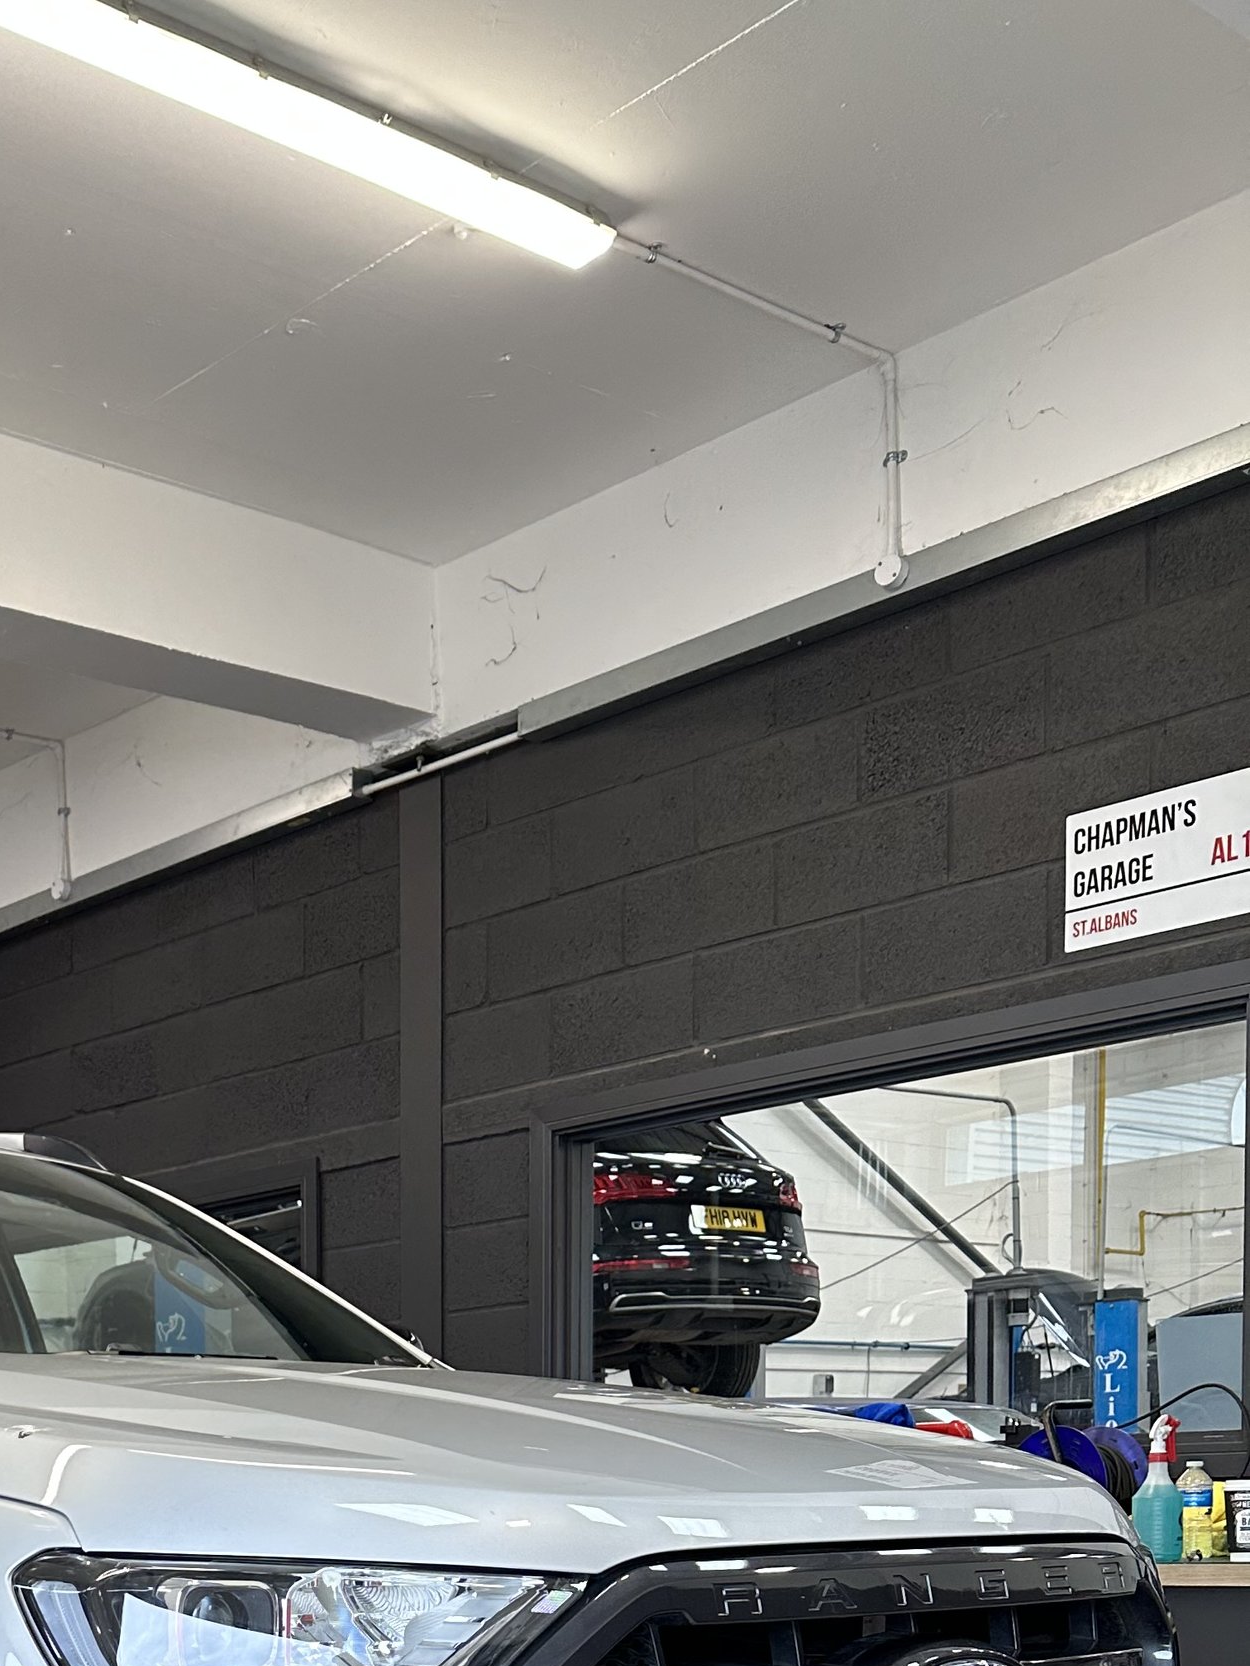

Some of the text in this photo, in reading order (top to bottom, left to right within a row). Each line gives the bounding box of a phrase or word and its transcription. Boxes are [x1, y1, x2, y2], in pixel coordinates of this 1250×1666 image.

[1074, 799, 1197, 855] CHAPMAN'S
[1073, 853, 1154, 898] GARAGE
[1072, 908, 1139, 938] ST.ALBANS
[712, 1561, 1128, 1618] RANGER
